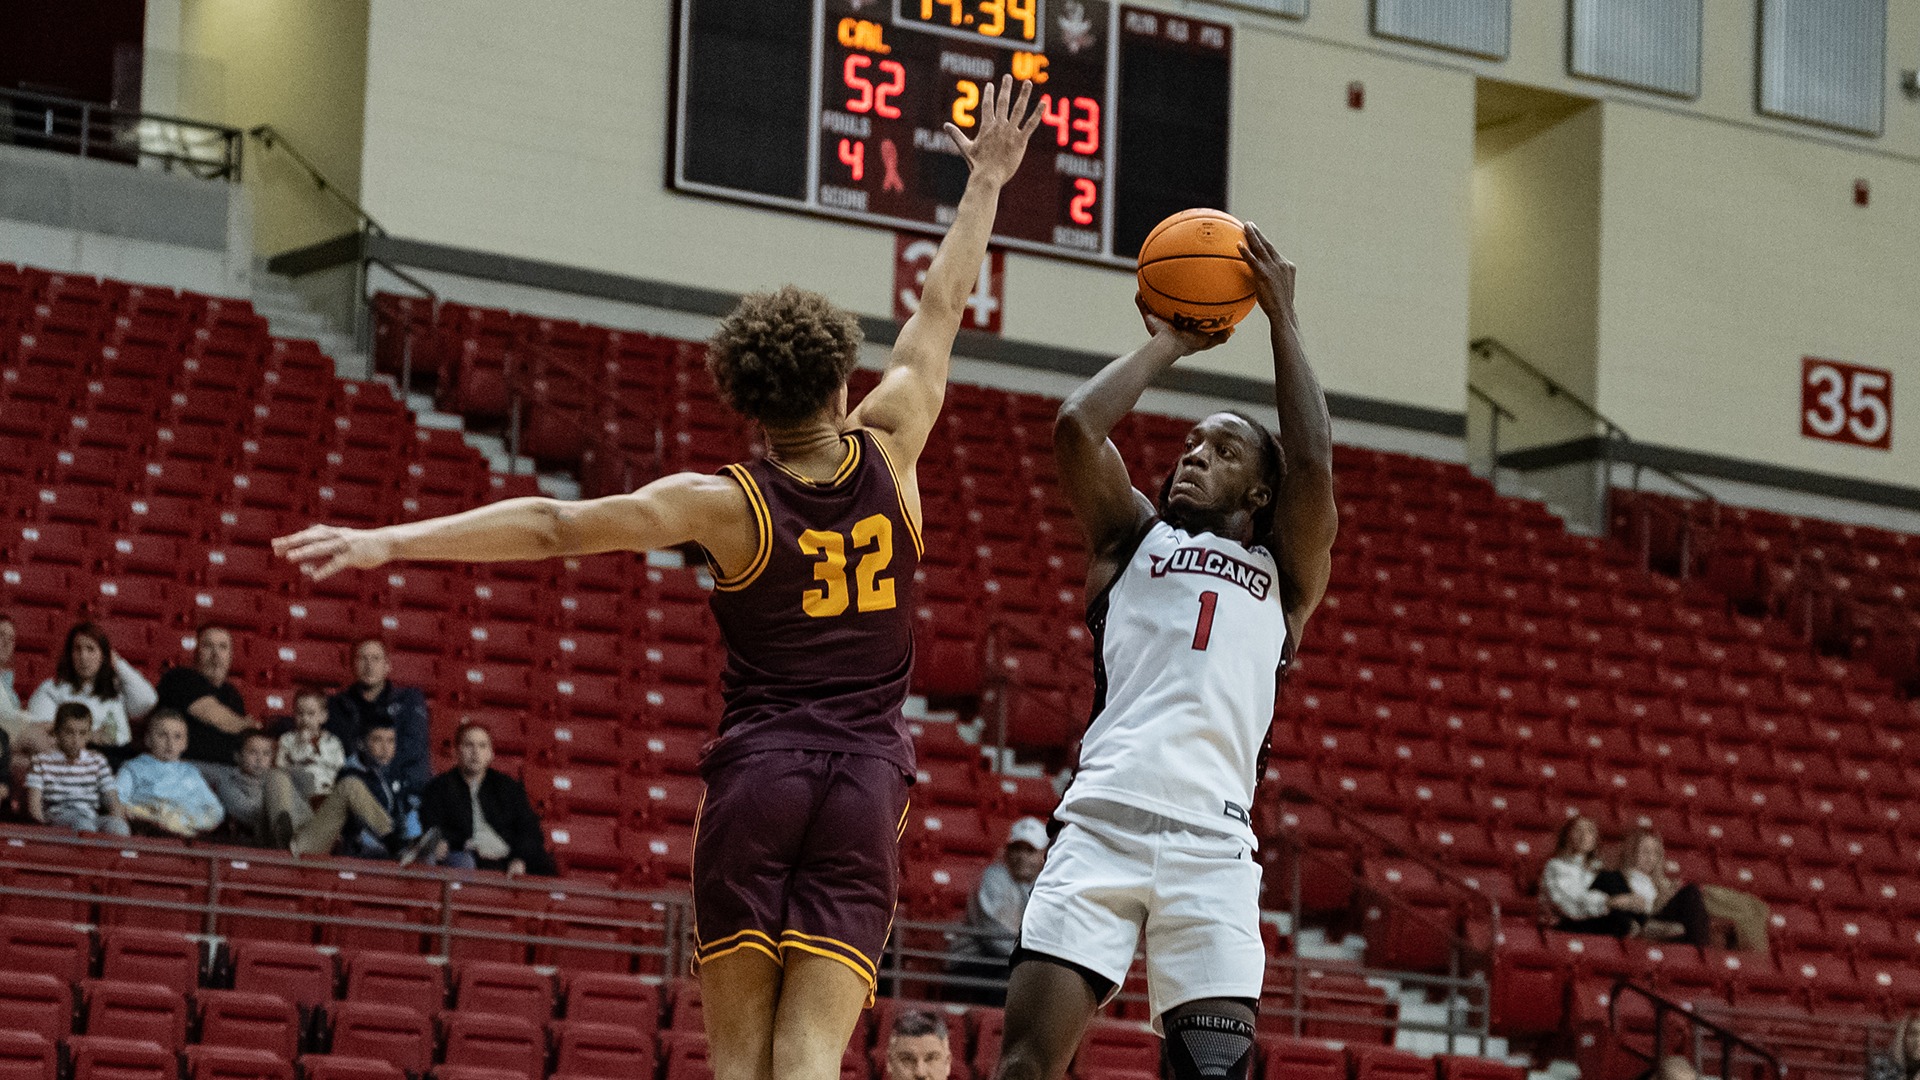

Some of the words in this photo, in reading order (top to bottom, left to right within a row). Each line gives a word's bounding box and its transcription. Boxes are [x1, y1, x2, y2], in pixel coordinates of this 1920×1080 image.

[837, 17, 892, 55] CAL
[843, 53, 906, 119] 52
[1011, 50, 1050, 84] UC
[952, 80, 980, 128] 2
[1041, 93, 1100, 155] 43
[838, 137, 865, 181] 4
[1069, 177, 1097, 225] 2
[1807, 365, 1888, 442] 35
[797, 513, 897, 618] 32
[1149, 547, 1272, 602] VULCANS
[1191, 590, 1219, 652] 1
